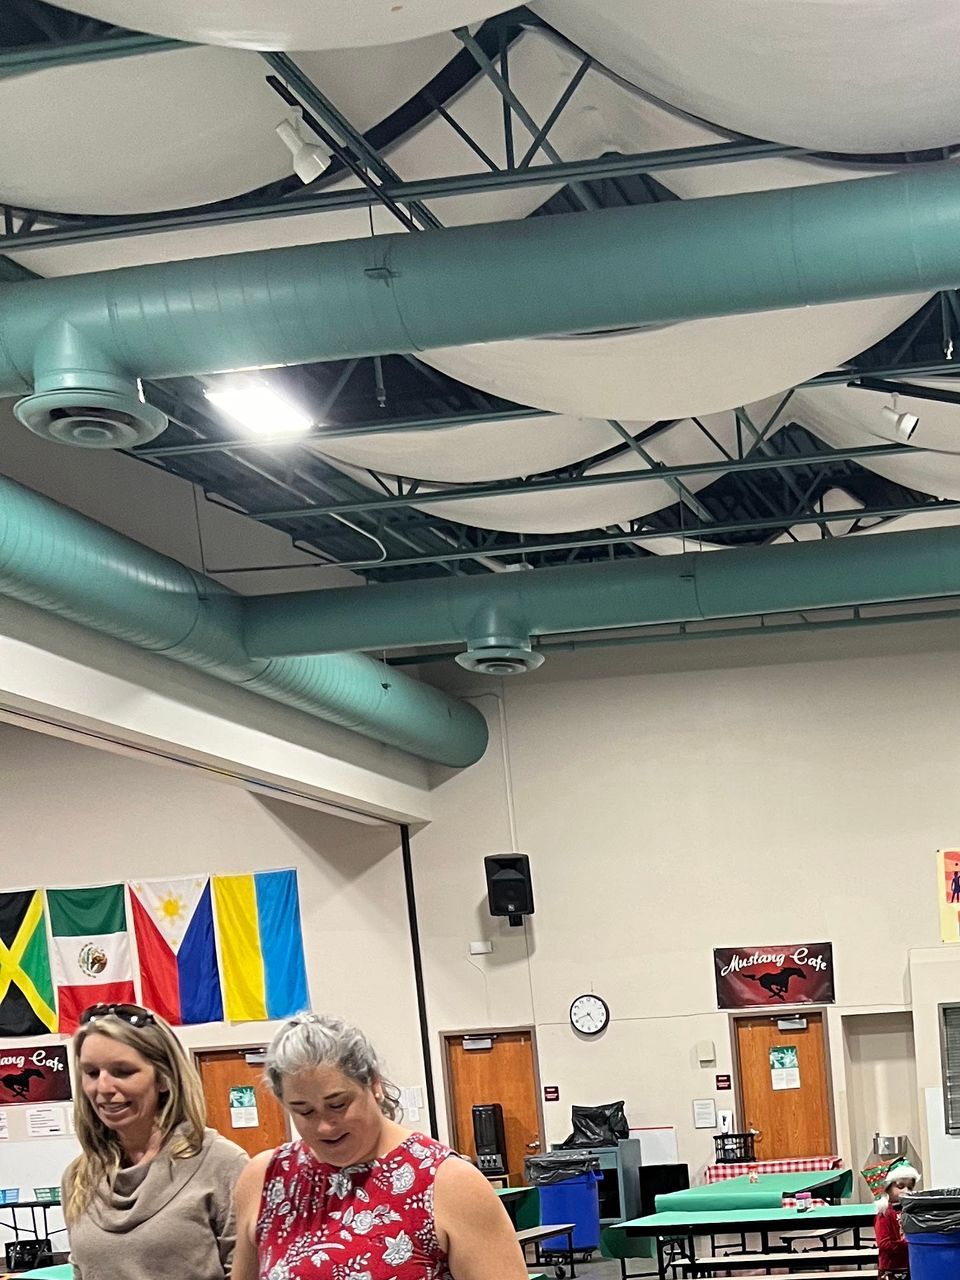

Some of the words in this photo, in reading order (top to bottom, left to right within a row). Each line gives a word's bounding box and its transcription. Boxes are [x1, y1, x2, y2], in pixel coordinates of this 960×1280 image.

[720, 951, 785, 977] Mustang
[790, 947, 828, 972] Cafe
[0, 1054, 25, 1068] ang
[29, 1050, 64, 1072] Cafe
